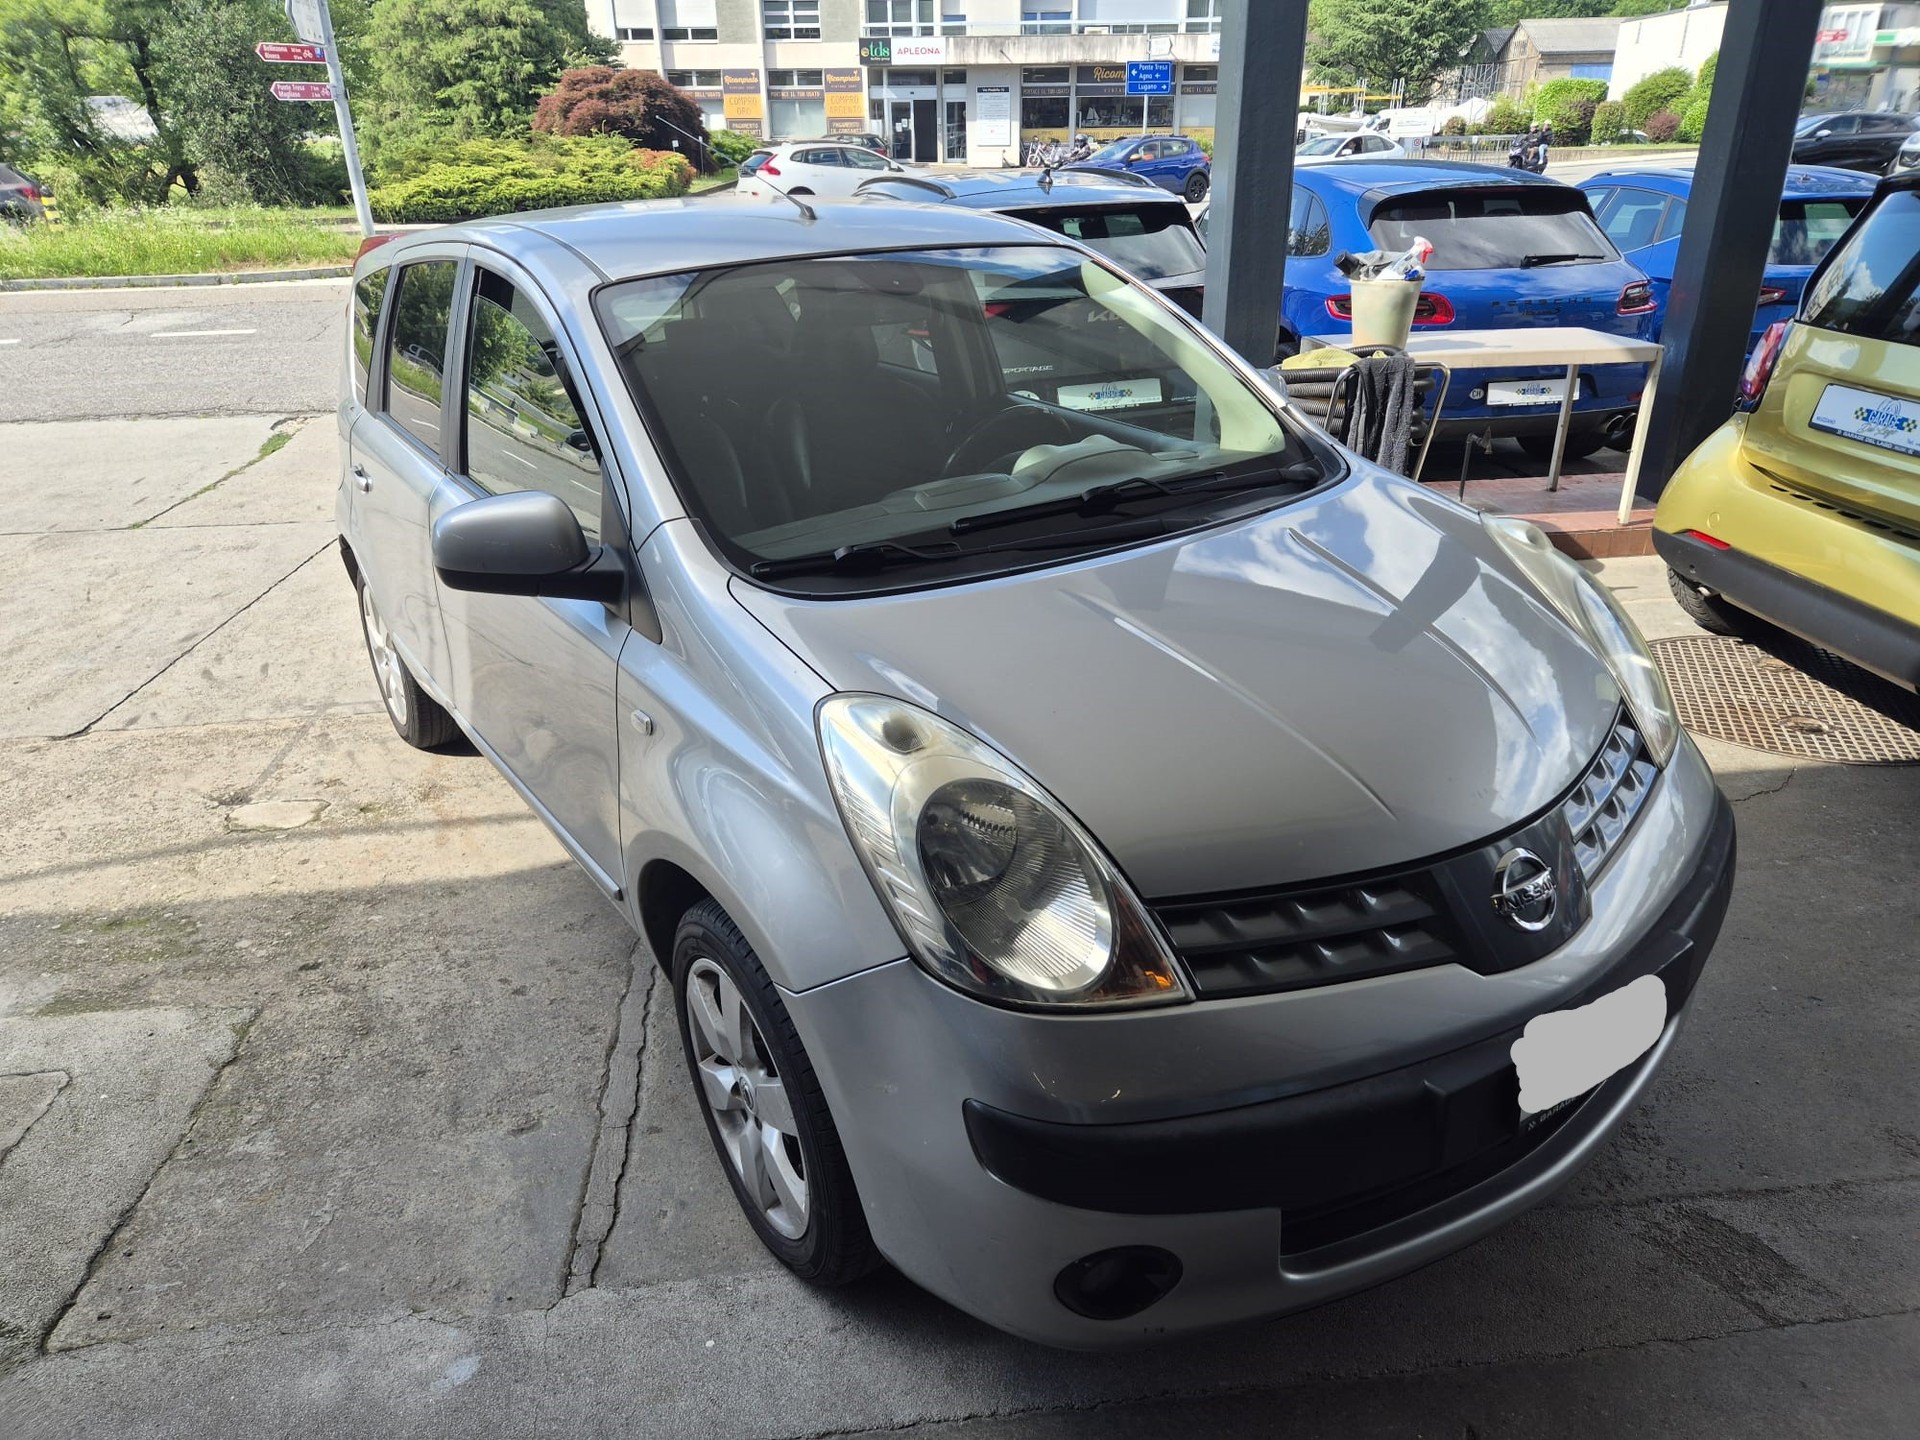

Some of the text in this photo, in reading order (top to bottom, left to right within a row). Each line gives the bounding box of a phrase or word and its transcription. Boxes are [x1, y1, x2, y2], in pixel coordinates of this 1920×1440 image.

[869, 41, 890, 57] tds
[897, 47, 941, 55] APLEONA
[1094, 66, 1126, 82] Ricom
[1139, 73, 1152, 81] Agno
[1138, 83, 1157, 91] Lugano
[729, 96, 758, 105] COMPRO
[830, 95, 859, 105] COMPRO
[736, 107, 752, 115] ORO
[829, 106, 861, 114] ARGENTO
[1868, 410, 1901, 428] GARAGE
